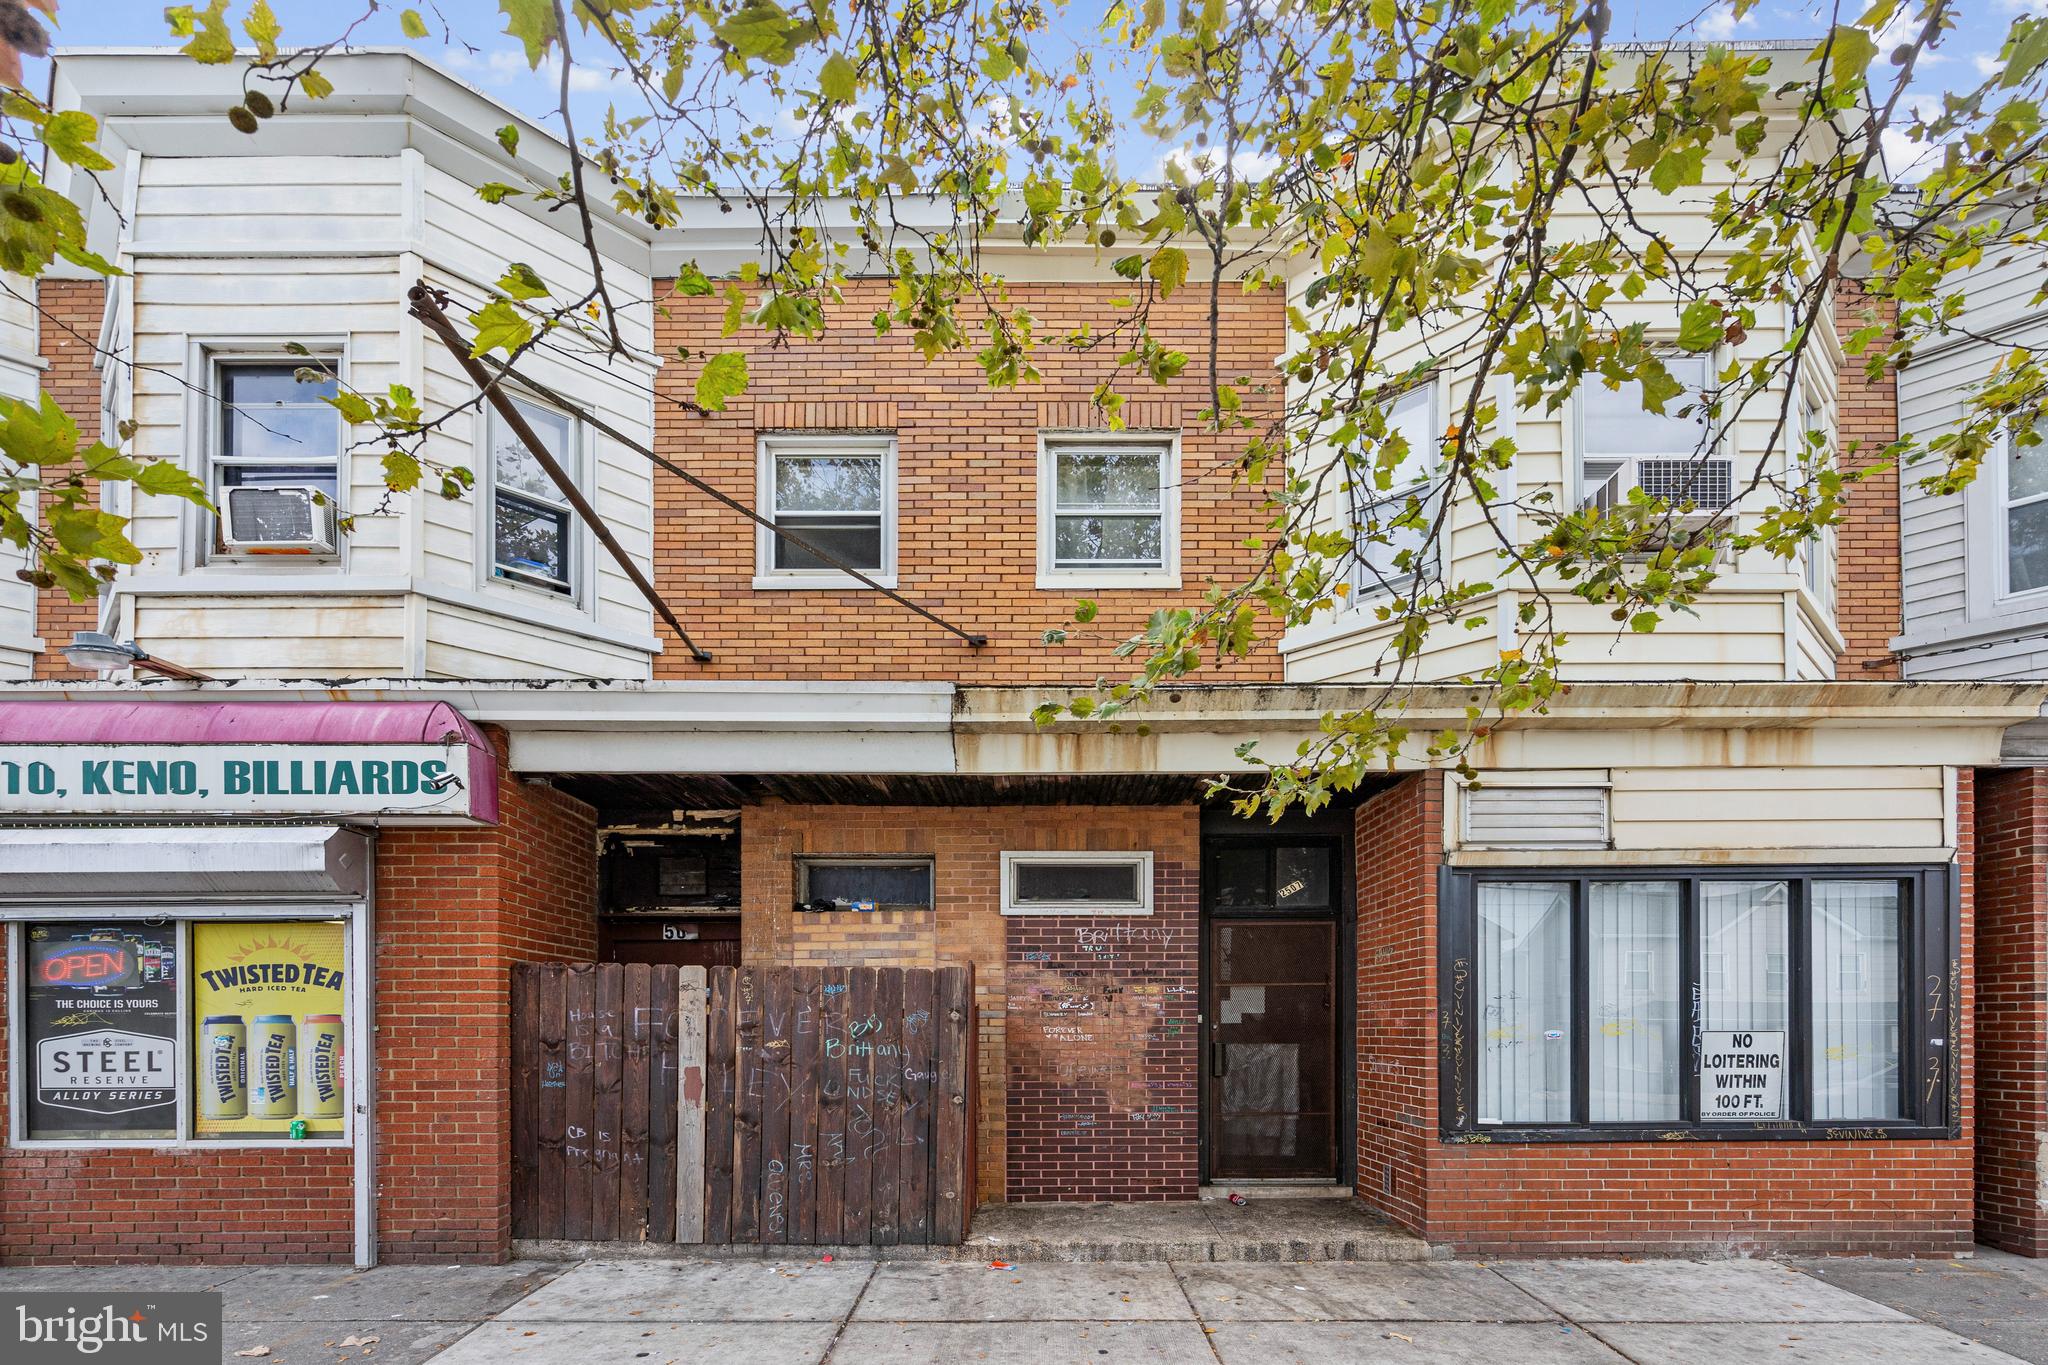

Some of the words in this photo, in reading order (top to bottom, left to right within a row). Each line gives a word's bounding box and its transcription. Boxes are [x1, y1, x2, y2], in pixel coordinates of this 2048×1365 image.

[82, 760, 209, 798] KENO,
[223, 760, 448, 794] BILLIARDS
[1279, 881, 1302, 897] 2507
[42, 951, 125, 981] OPEN
[200, 963, 300, 992] TWISTED
[303, 962, 344, 991] TEA
[56, 1000, 75, 1009] THE
[77, 1000, 112, 1009] CHOICE
[114, 1000, 124, 1009] IS
[127, 1000, 159, 1009] YOURS
[1042, 1026, 1084, 1035] FOREVER
[1059, 1033, 1094, 1042] ALONE
[265, 1033, 286, 1054] TEA
[314, 1033, 335, 1054] TEA
[1732, 1034, 1753, 1048] NO
[53, 1051, 162, 1073] STEEL
[1703, 1054, 1780, 1069] LOITERING
[70, 1076, 149, 1085] RESERVE
[215, 1055, 236, 1104] TWISTED
[265, 1055, 286, 1103] TWISTED
[315, 1055, 336, 1102] TWISTED
[1715, 1074, 1767, 1089] WITHIN
[53, 1091, 102, 1101] ALLOY
[108, 1091, 163, 1101] SERIES
[1715, 1095, 1740, 1109] 100
[1744, 1094, 1764, 1109] FT.
